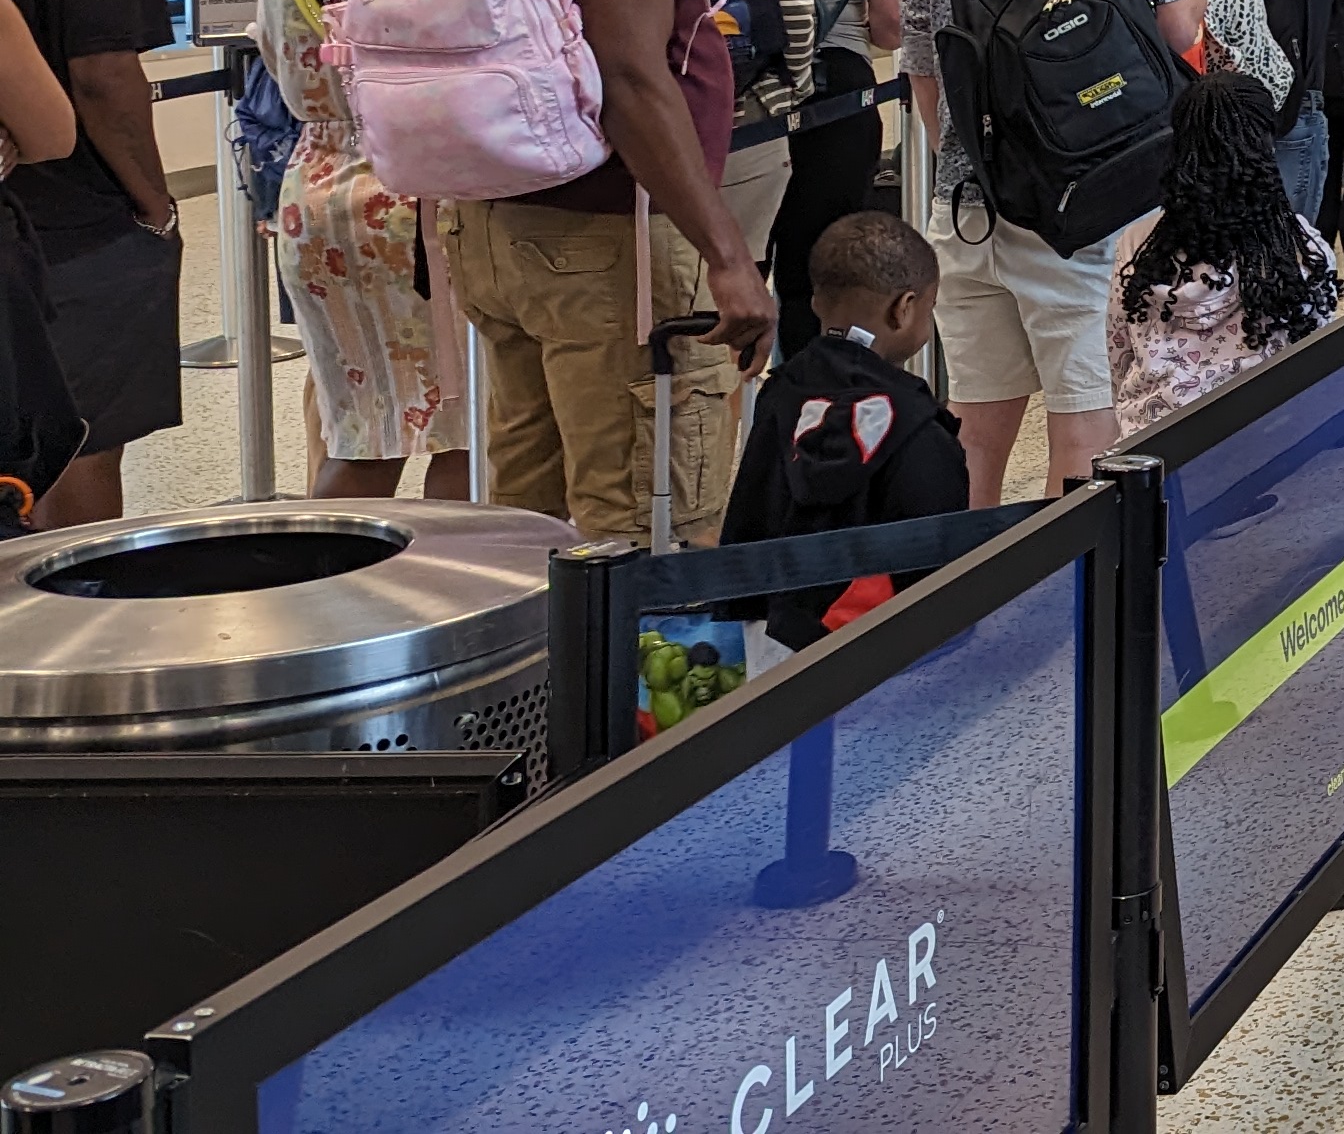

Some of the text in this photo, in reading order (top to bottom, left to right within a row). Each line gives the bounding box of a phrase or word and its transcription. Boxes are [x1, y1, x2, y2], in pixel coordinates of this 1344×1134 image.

[1044, 13, 1089, 41] OGIO
[1280, 589, 1344, 662] Welcome
[880, 1002, 937, 1083] PLUS
